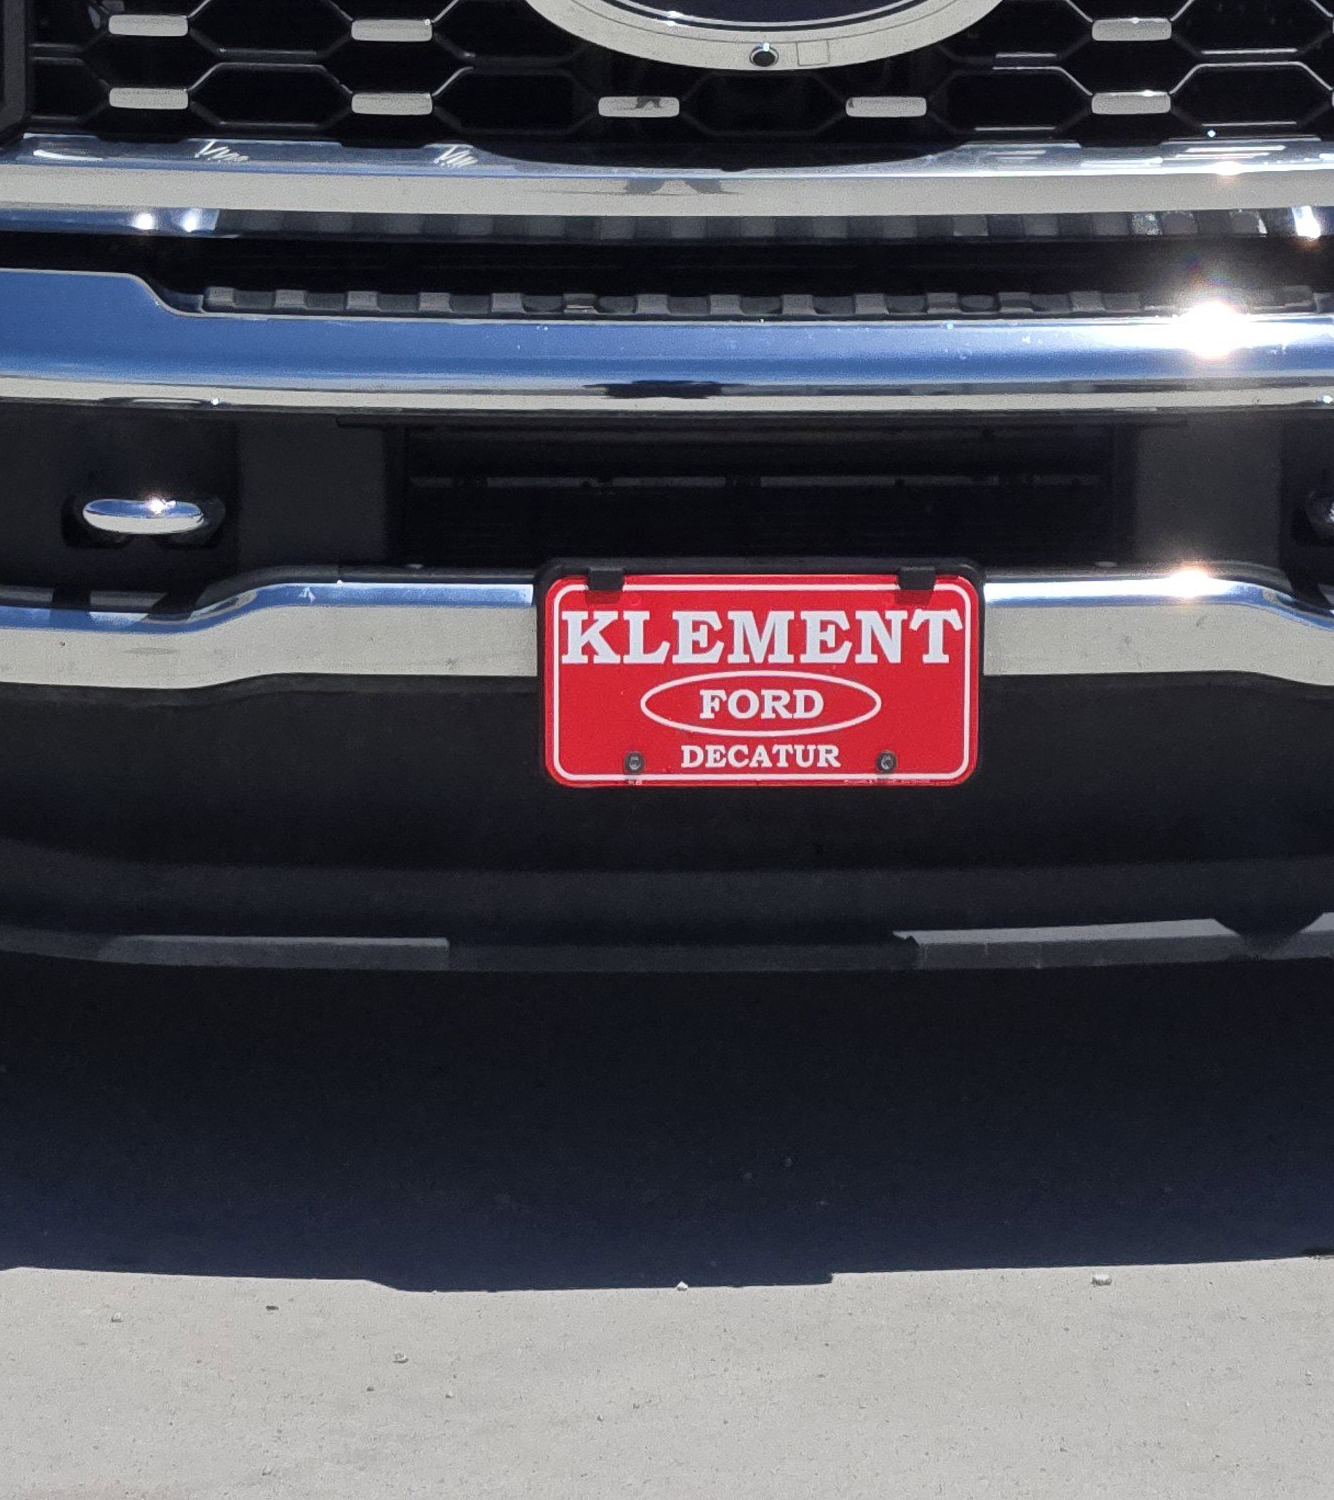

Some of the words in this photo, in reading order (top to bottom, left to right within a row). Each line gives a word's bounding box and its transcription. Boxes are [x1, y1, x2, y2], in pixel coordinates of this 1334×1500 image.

[560, 608, 964, 665] KLEMENT
[699, 688, 824, 720] FORD
[680, 743, 842, 768] DECATUR
